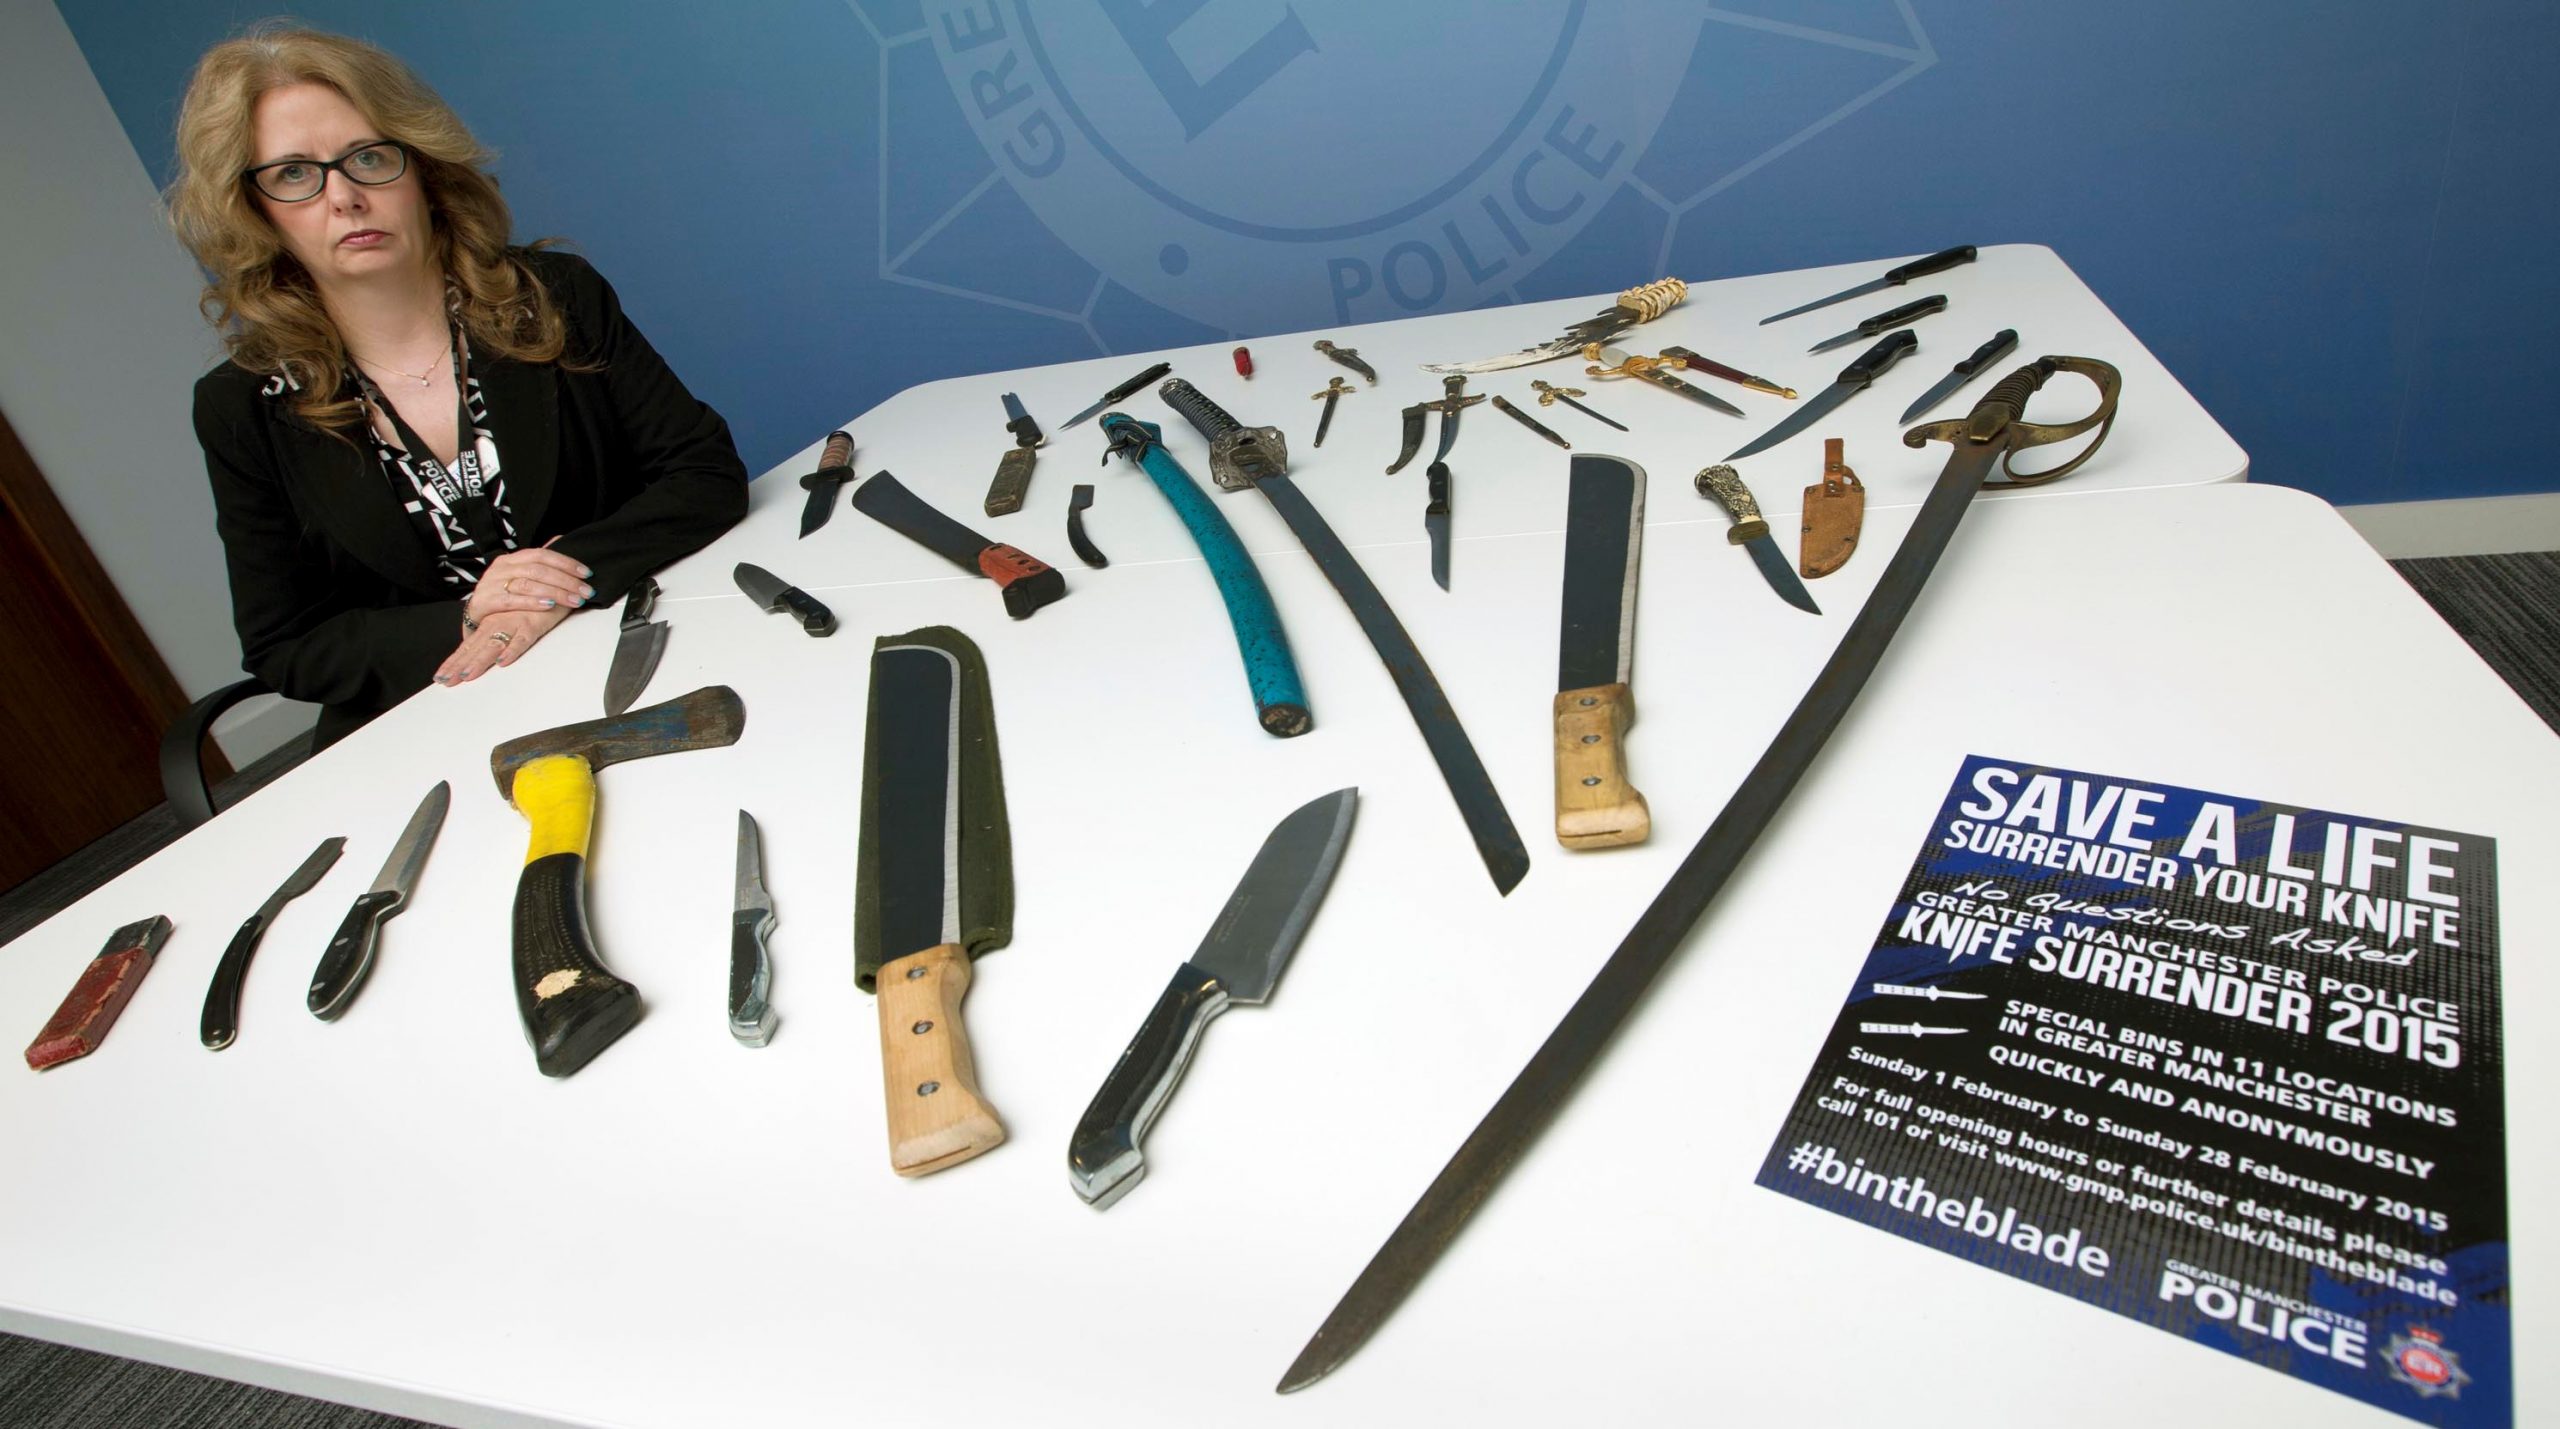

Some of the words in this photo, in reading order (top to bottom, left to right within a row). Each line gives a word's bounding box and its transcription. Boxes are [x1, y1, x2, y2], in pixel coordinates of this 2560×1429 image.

[1326, 105, 1625, 324] POLICE
[420, 460, 458, 505] POLICE
[464, 449, 485, 498] POLICE
[1944, 820, 2179, 891] SURRENDER
[2193, 863, 2308, 917] YOUR
[2321, 888, 2460, 948] KNIFE
[1960, 767, 2166, 850] SAVE
[2178, 801, 2237, 867] A
[2267, 813, 2460, 907] LIFE
[1898, 905, 2024, 964] KNIFE
[2028, 935, 2312, 1035] SURRENDER
[2326, 1001, 2460, 1069] 2015
[1916, 891, 2054, 933] GREATER
[2063, 921, 2307, 990] MANCHESTER
[2320, 976, 2459, 1023] POLICE
[1953, 880, 2009, 900] No
[2025, 893, 2250, 940] Questions
[2270, 928, 2418, 967] Asked
[1989, 1045, 2106, 1088] QUICKLY
[2108, 1077, 2175, 1108] AND
[2180, 1097, 2436, 1180] ANONYMOUSLY
[1998, 1016, 2029, 1037] IN
[2034, 1026, 2157, 1070] GREATER
[2163, 1058, 2372, 1128] MANCHESTER
[2004, 999, 2111, 1039] SPECIAL
[2118, 1027, 2184, 1057] BINS
[2191, 1045, 2224, 1068] IN
[2233, 1057, 2264, 1078] 11
[2275, 1066, 2457, 1127] LOCATIONS
[1817, 1095, 1858, 1117] call
[1863, 1107, 1900, 1131] 101
[1905, 1123, 1933, 1141] or
[1938, 1132, 1990, 1160] visit
[1994, 1149, 2458, 1307] www.gmp.police.uk/bintheblade
[1833, 1075, 1870, 1098] For
[1874, 1087, 1914, 1112] full
[1916, 1104, 2013, 1146] opening
[2018, 1130, 2089, 1167] hours
[2095, 1157, 2126, 1177] or
[2131, 1164, 2230, 1208] further
[2236, 1198, 2337, 1242] details
[2344, 1231, 2449, 1276] please
[1848, 1045, 1929, 1083] Sunday
[1935, 1070, 1946, 1086] 1
[1951, 1075, 2057, 1120] February
[2063, 1108, 2090, 1127] to
[2096, 1117, 2192, 1159] Sunday
[2198, 1146, 2232, 1169] 28
[2238, 1156, 2368, 1211] February
[2375, 1195, 2449, 1232] 2015
[1788, 1141, 2110, 1278] #bintheblade
[2159, 1269, 2368, 1369] POLICE
[2165, 1258, 2241, 1293] GREATER
[2243, 1283, 2368, 1334] MANCHESTER
